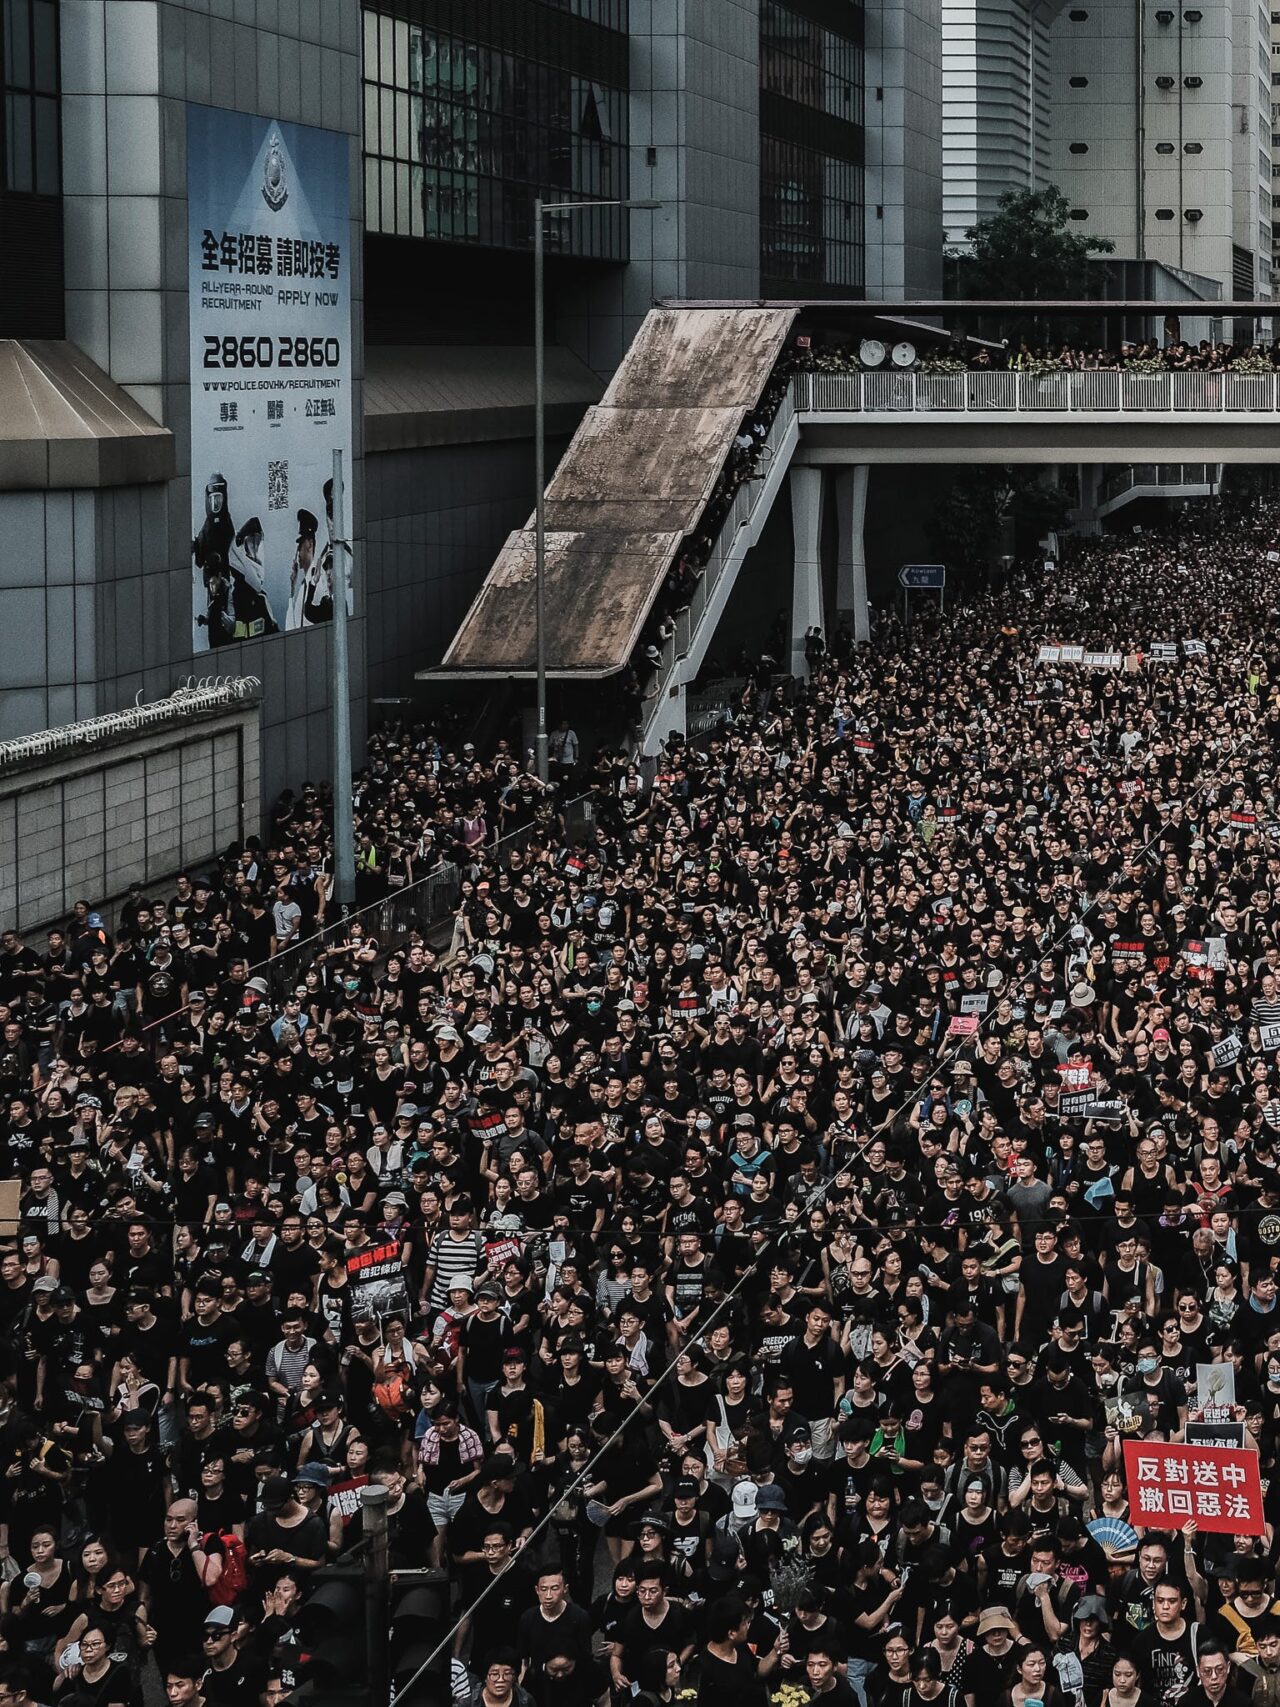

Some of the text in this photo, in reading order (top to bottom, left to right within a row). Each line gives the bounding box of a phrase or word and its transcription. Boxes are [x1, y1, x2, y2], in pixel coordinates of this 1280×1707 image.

[201, 229, 340, 279] 全年招募 請即投考
[202, 281, 274, 296] ALL-YEAR-ROUND
[202, 298, 262, 311] RECRUITMENT
[278, 290, 339, 307] APPLY NOW
[204, 336, 340, 368] 2860 2860
[203, 379, 341, 391] WWW.POLICE.GOV.HK/RECRUITMENT
[220, 398, 336, 422] 專業 關懷 公正無私
[1216, 1042, 1234, 1056] 612
[709, 1096, 734, 1104] HOLLISTER
[359, 1261, 401, 1279] 逃犯條例
[1204, 1408, 1230, 1418] 反送中
[1137, 1457, 1246, 1489] 反對送中
[1138, 1486, 1251, 1519] 撤回惡法
